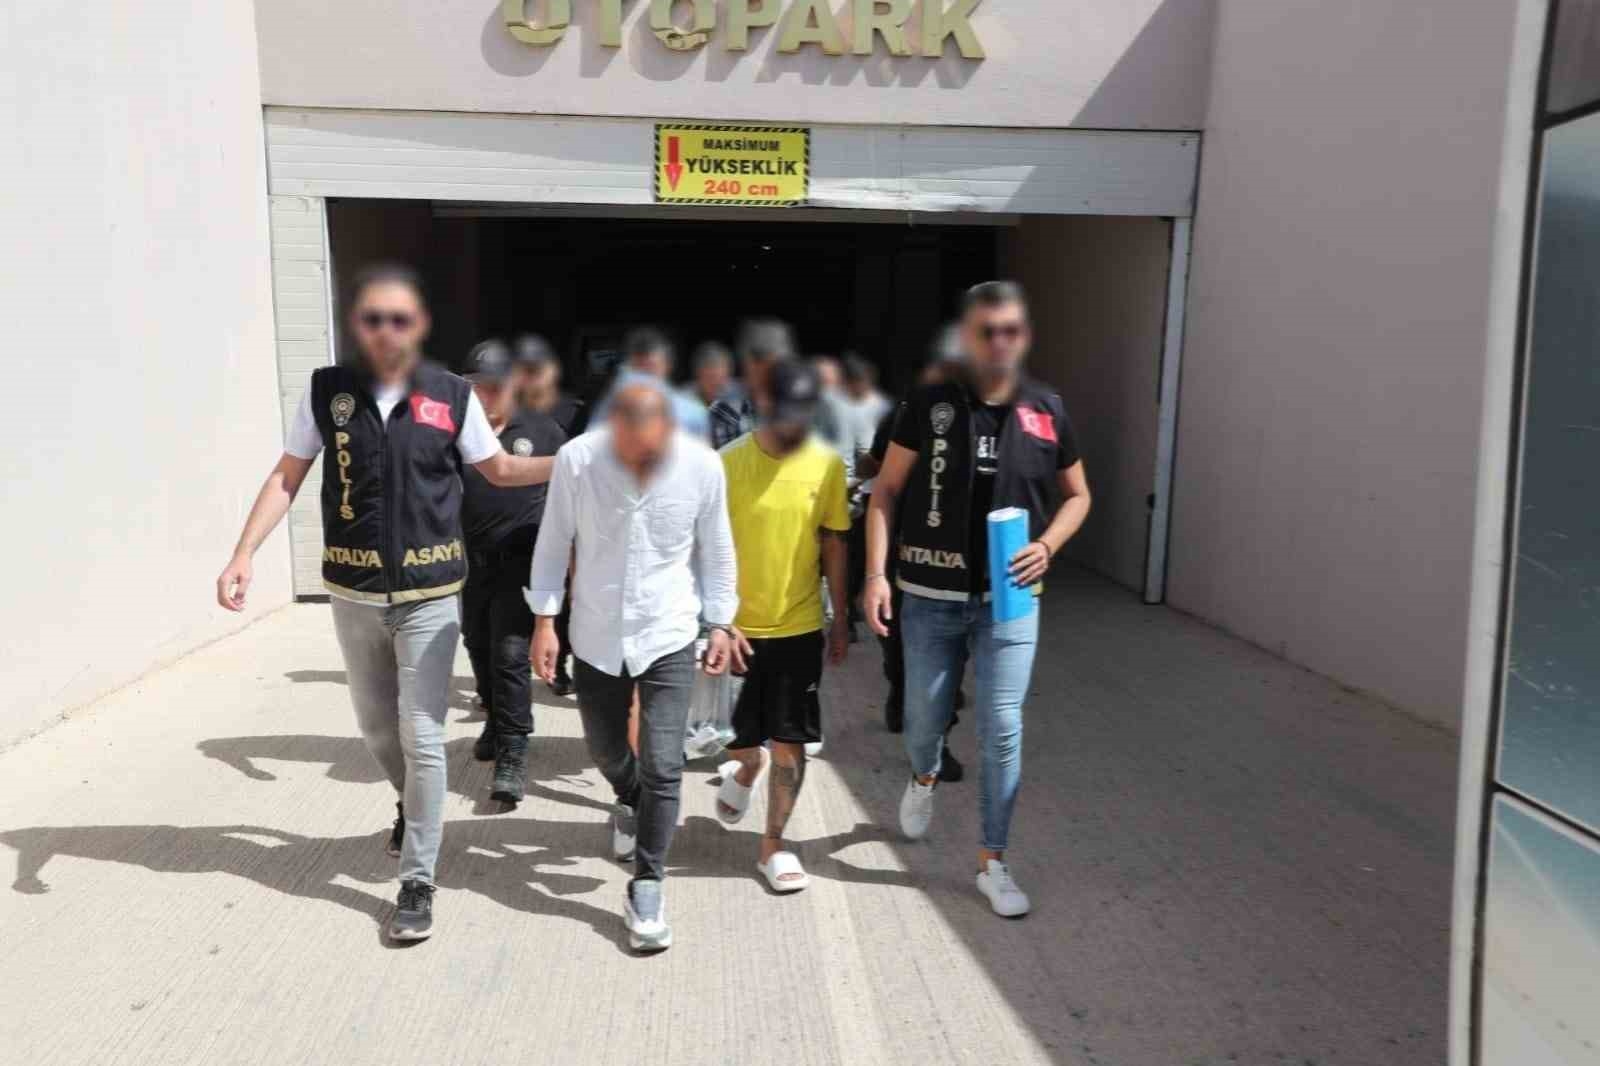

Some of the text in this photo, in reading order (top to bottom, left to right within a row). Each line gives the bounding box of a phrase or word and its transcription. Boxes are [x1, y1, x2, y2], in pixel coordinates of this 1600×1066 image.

[703, 137, 780, 151] MAKSİMUM
[685, 155, 798, 176] YÜKSEKLİK
[704, 179, 779, 197] 240 cm
[321, 538, 461, 568] NTALYA ASAYİ
[900, 545, 968, 569] NTALYA
